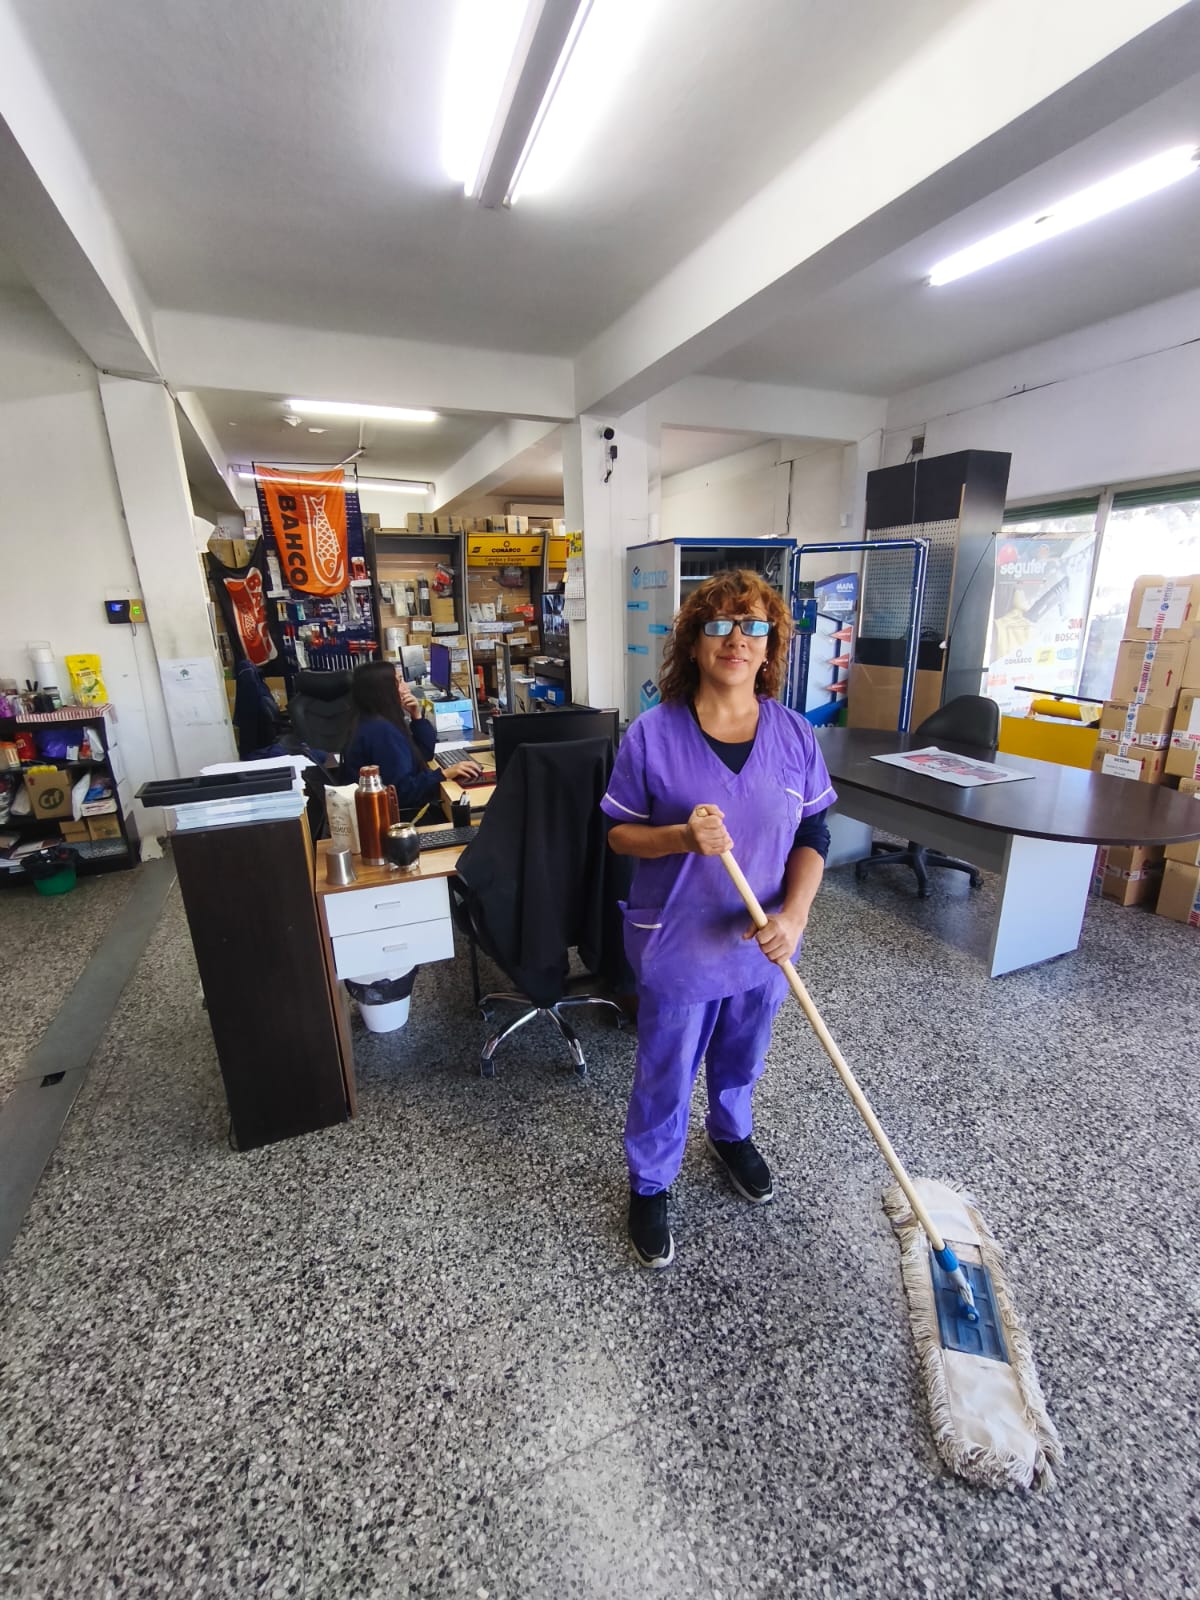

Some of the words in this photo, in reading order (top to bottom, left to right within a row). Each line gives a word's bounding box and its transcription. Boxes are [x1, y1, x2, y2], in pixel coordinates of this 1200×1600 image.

[278, 495, 309, 586] BAHCO
[999, 560, 1047, 577] segufer
[1067, 618, 1083, 630] 3M
[1055, 632, 1080, 642] BOSCH
